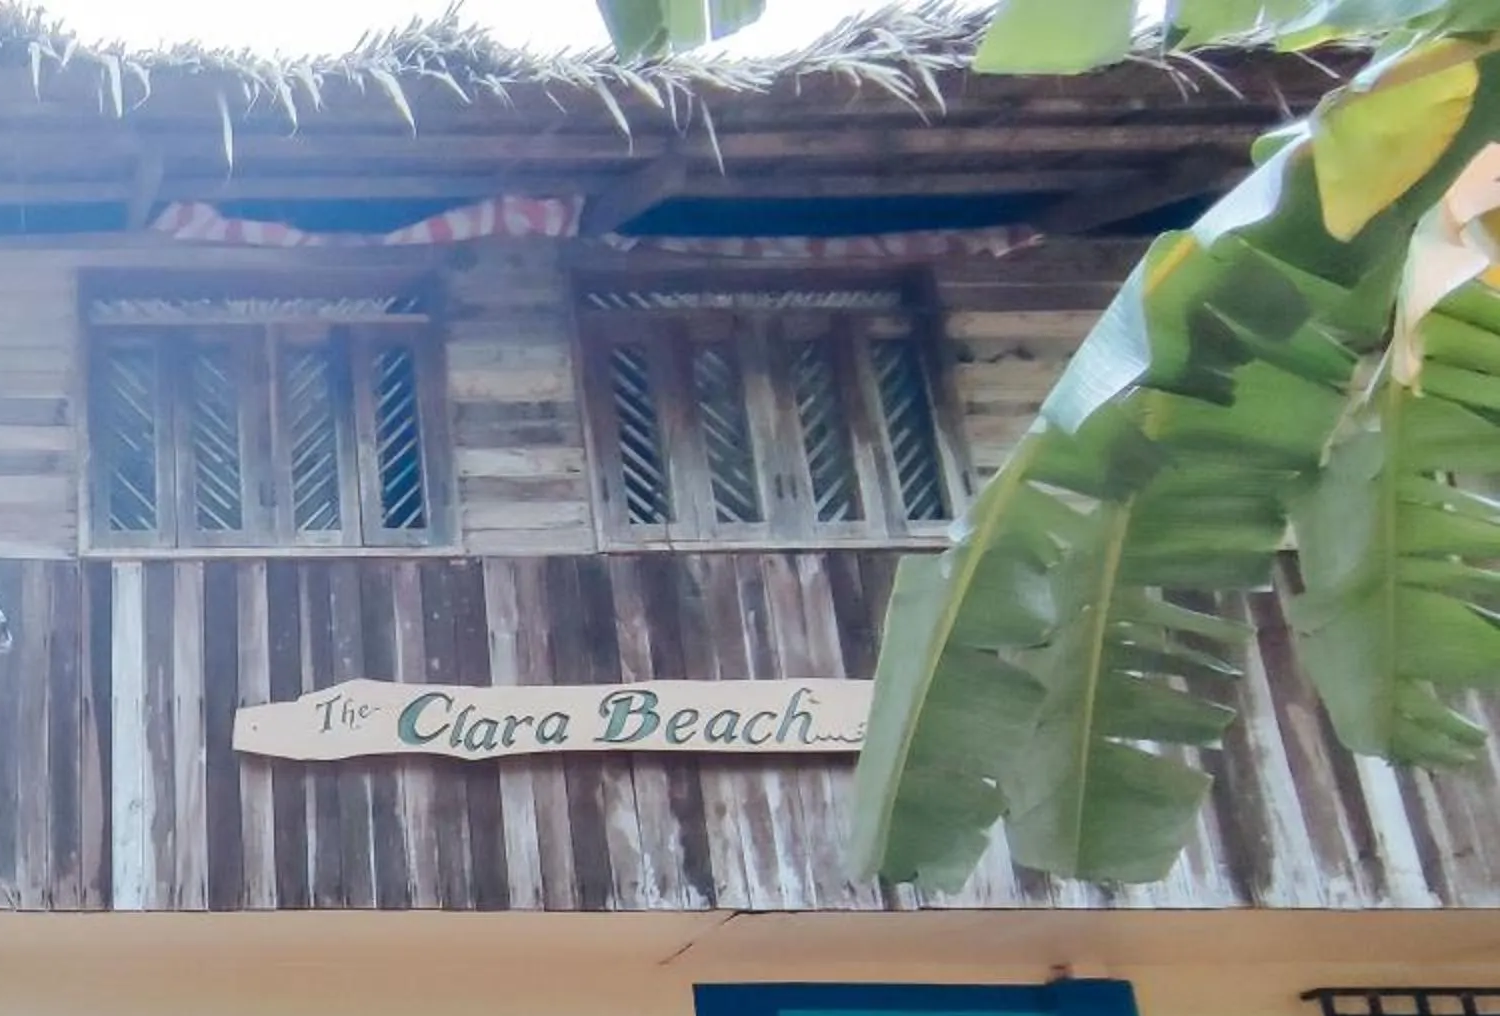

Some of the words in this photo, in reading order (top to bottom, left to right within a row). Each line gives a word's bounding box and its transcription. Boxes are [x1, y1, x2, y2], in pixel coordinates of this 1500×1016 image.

[315, 692, 376, 734] The
[397, 691, 572, 752] Clara
[592, 687, 818, 746] Beach
